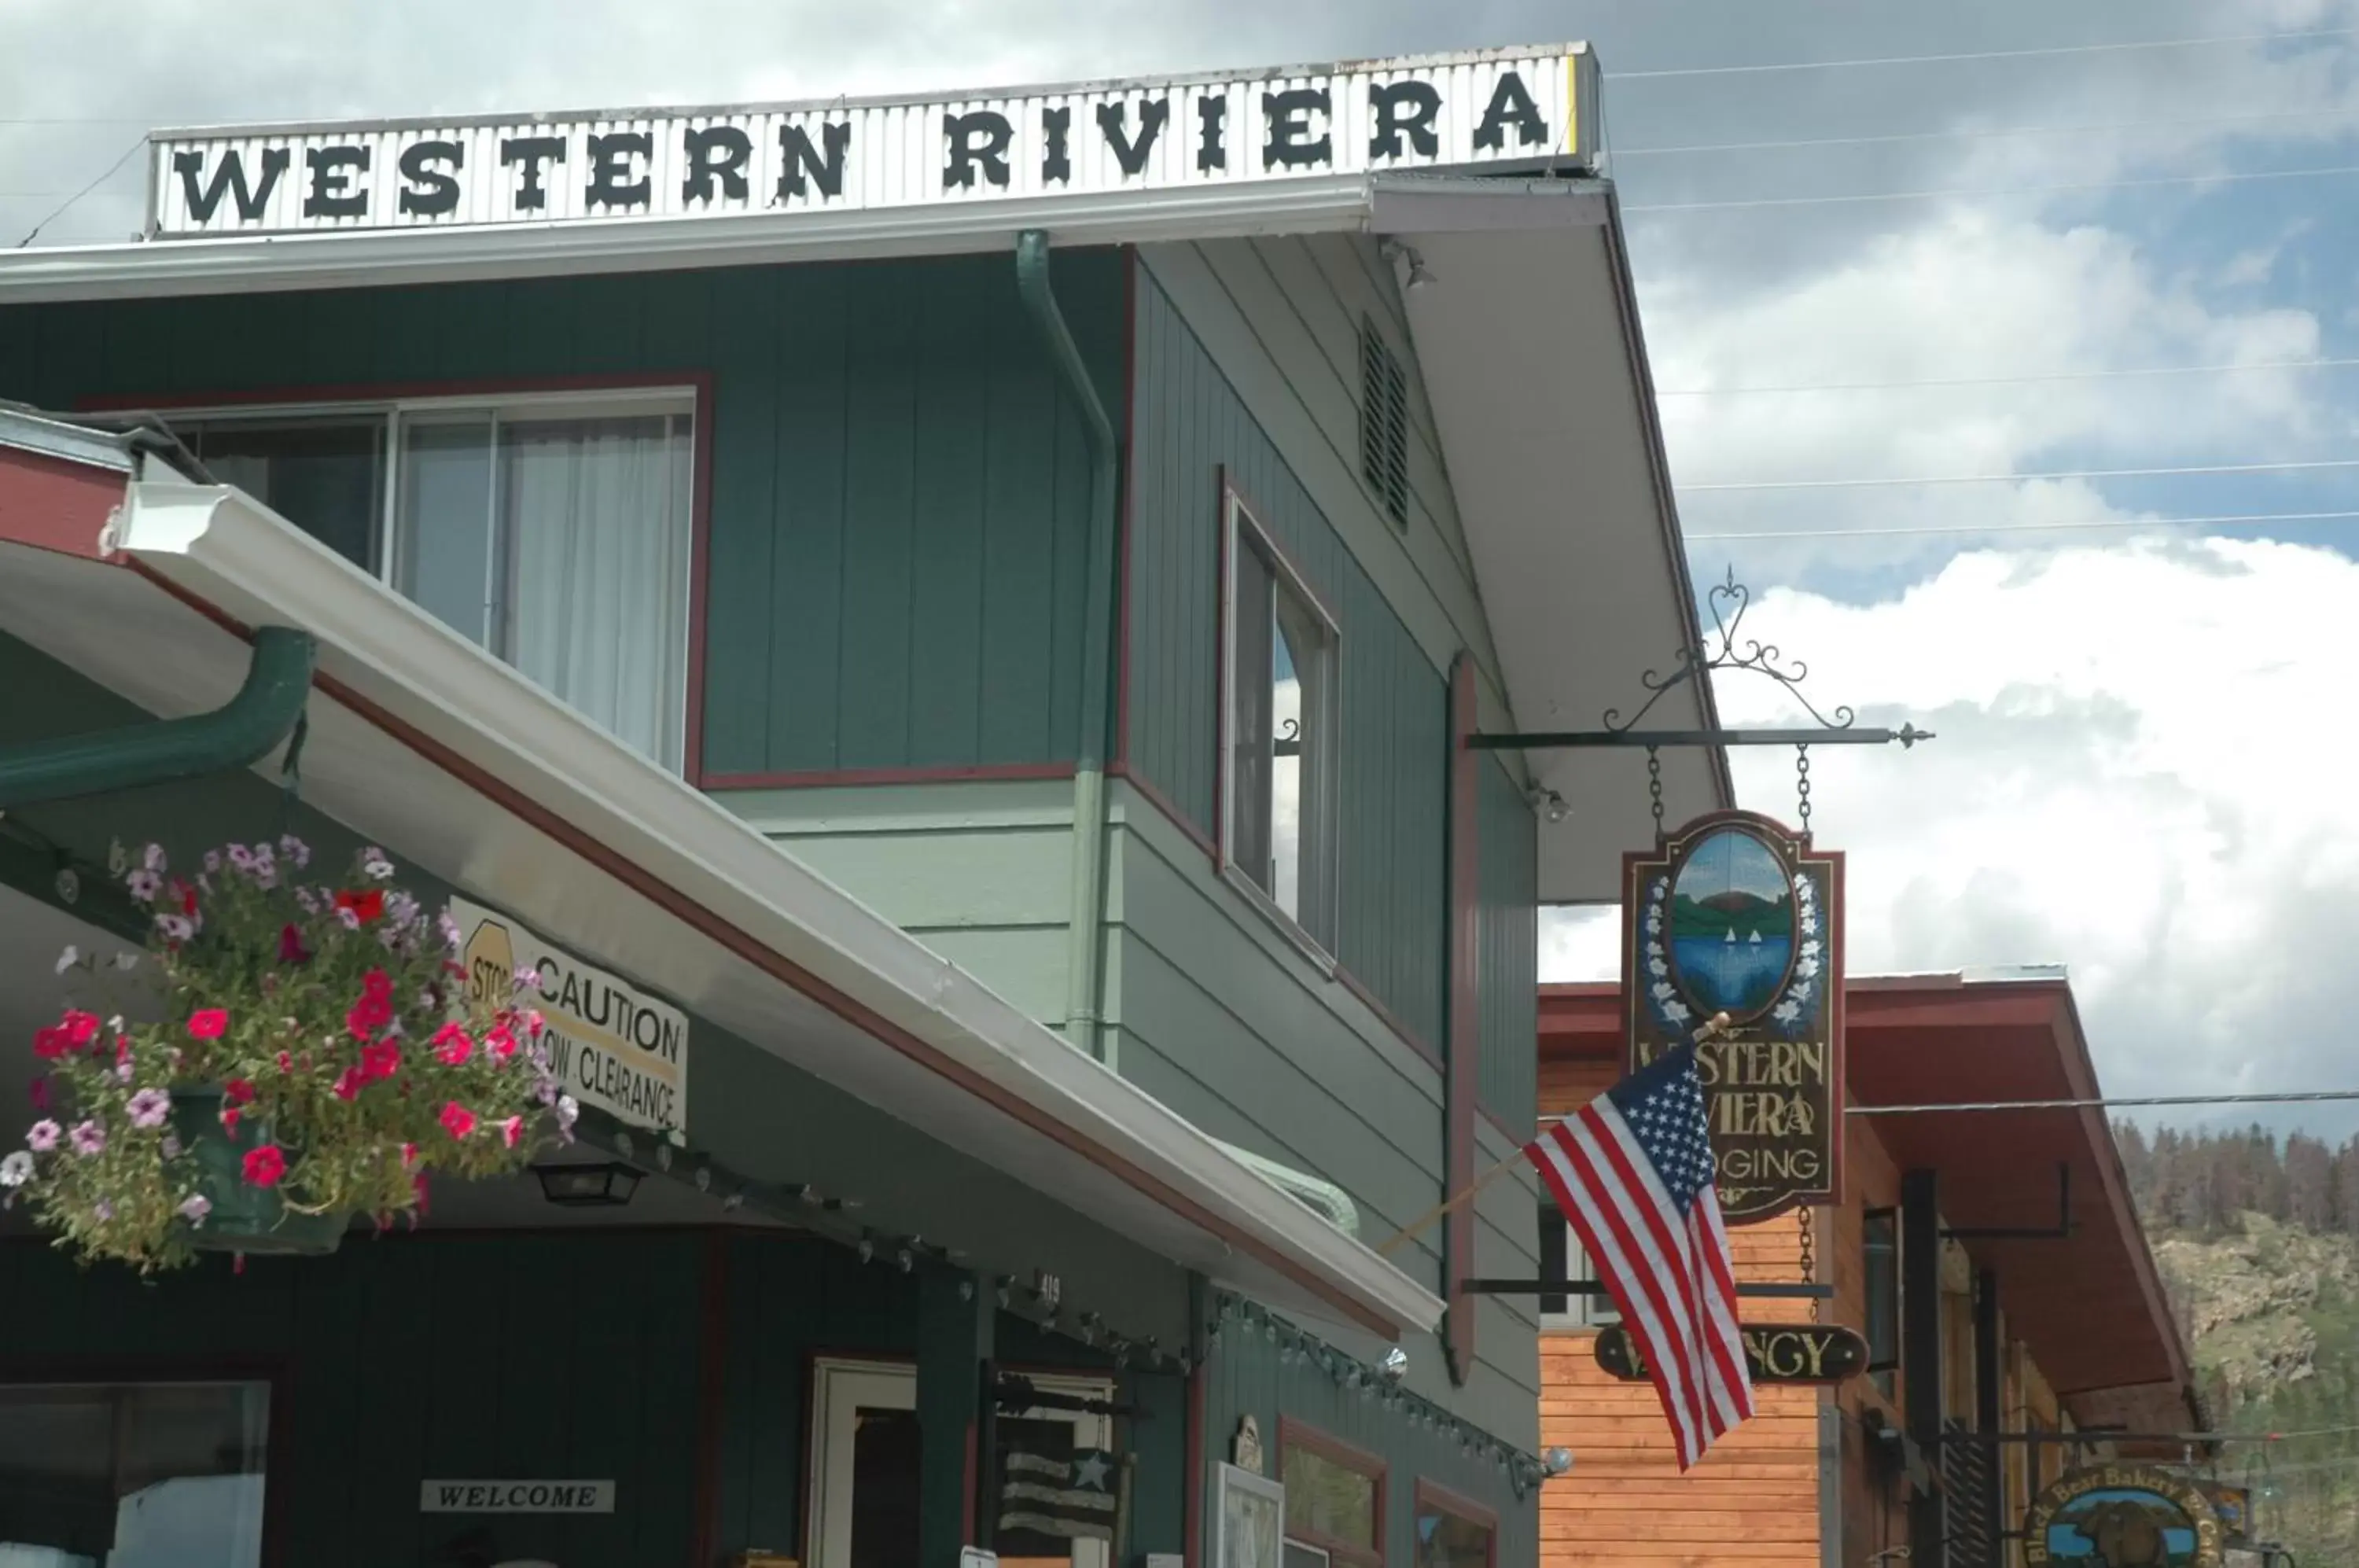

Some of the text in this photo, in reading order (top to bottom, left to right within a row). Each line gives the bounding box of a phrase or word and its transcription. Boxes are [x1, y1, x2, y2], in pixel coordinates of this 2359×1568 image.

[173, 72, 1548, 221] WESTERN RIVIERA
[473, 955, 508, 1003] STO
[535, 956, 679, 1064] CAUTION
[533, 1029, 571, 1080] OW
[1640, 1040, 1824, 1085] STERN
[1713, 1149, 1820, 1180] GING
[438, 1485, 596, 1507] WELCOME
[2051, 1473, 2101, 1504] Bear
